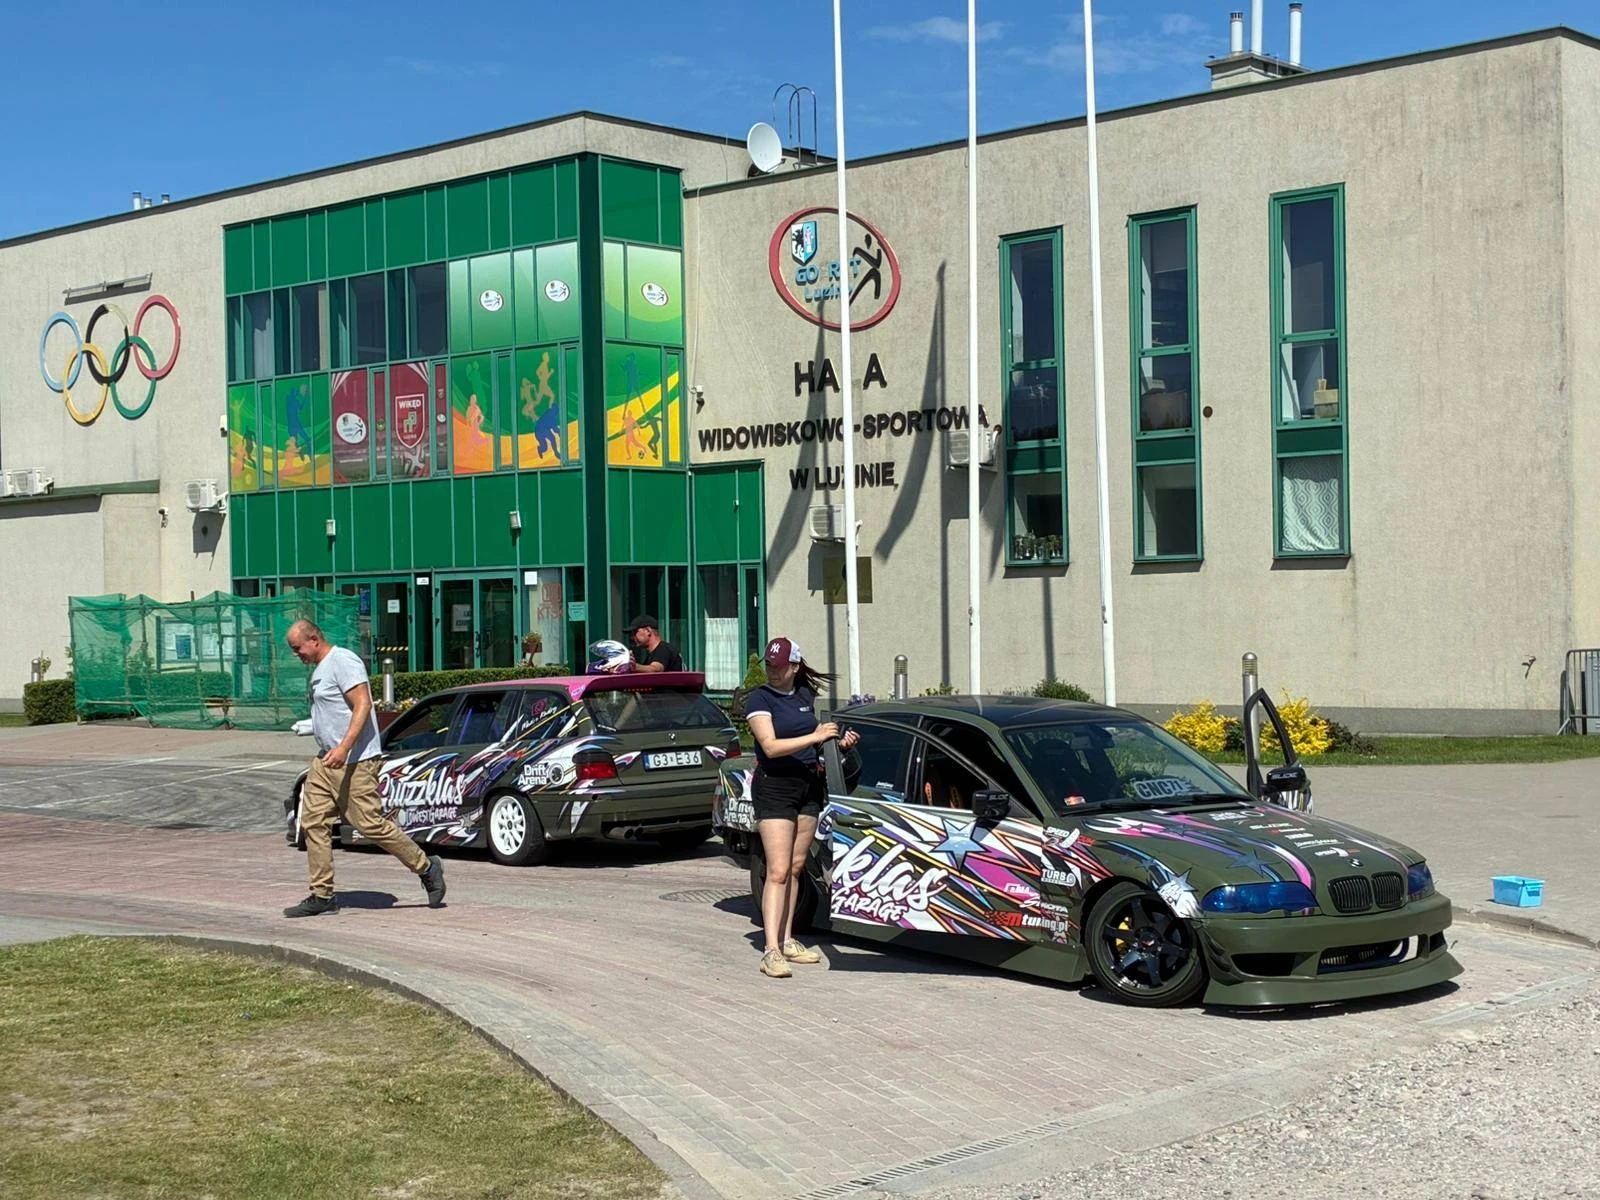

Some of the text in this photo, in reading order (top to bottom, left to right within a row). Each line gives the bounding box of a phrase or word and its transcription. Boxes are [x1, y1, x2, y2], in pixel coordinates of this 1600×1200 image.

[795, 256, 861, 286] GO RT
[794, 353, 887, 397] HAA
[789, 467, 810, 490] W
[524, 764, 547, 776] Drift
[653, 751, 699, 767] G3 E36
[518, 774, 547, 786] Arena
[831, 886, 910, 922] GARAGE
